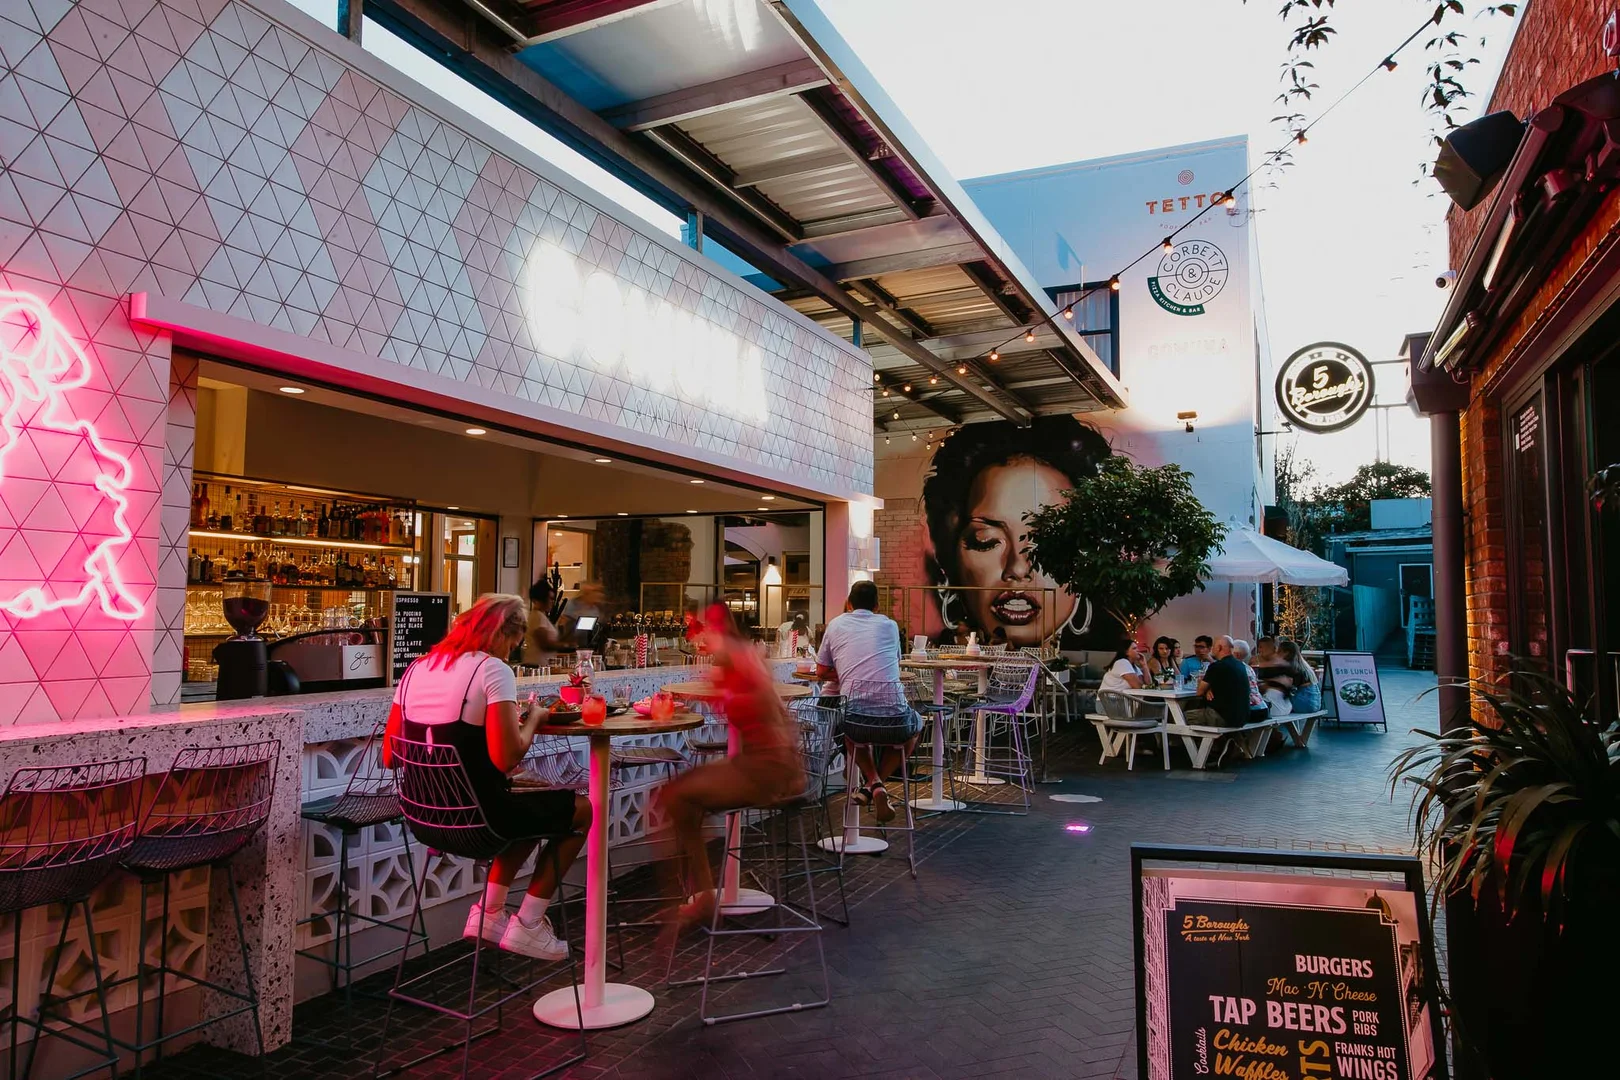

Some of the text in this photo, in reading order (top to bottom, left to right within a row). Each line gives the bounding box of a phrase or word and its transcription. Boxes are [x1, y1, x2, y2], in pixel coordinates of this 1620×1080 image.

[1163, 244, 1223, 272] CORBETT
[1188, 269, 1196, 278] &
[1151, 281, 1160, 297] PIZZA
[1159, 295, 1182, 313] KITCHEN
[1166, 277, 1221, 302] CLAUDE
[1313, 366, 1329, 388] 5
[1289, 376, 1363, 408] Boroughs
[1183, 915, 1250, 932] 5 Boroughs
[1184, 934, 1192, 942] A
[1208, 934, 1216, 942] of
[1218, 933, 1232, 941] New
[1295, 954, 1373, 978] BURGERS
[1266, 977, 1300, 997] Mac
[1332, 982, 1378, 1002] Cheese
[1208, 995, 1347, 1035] TAP BEERS
[1352, 1010, 1379, 1024] PORK
[1354, 1023, 1377, 1036] RIBS
[1193, 1026, 1209, 1074] Cocktails
[1213, 1028, 1288, 1056] Chicken
[1335, 1041, 1396, 1059] FRANKS HOT
[1215, 1052, 1289, 1080] Waffles
[1336, 1056, 1398, 1080] WINGS
